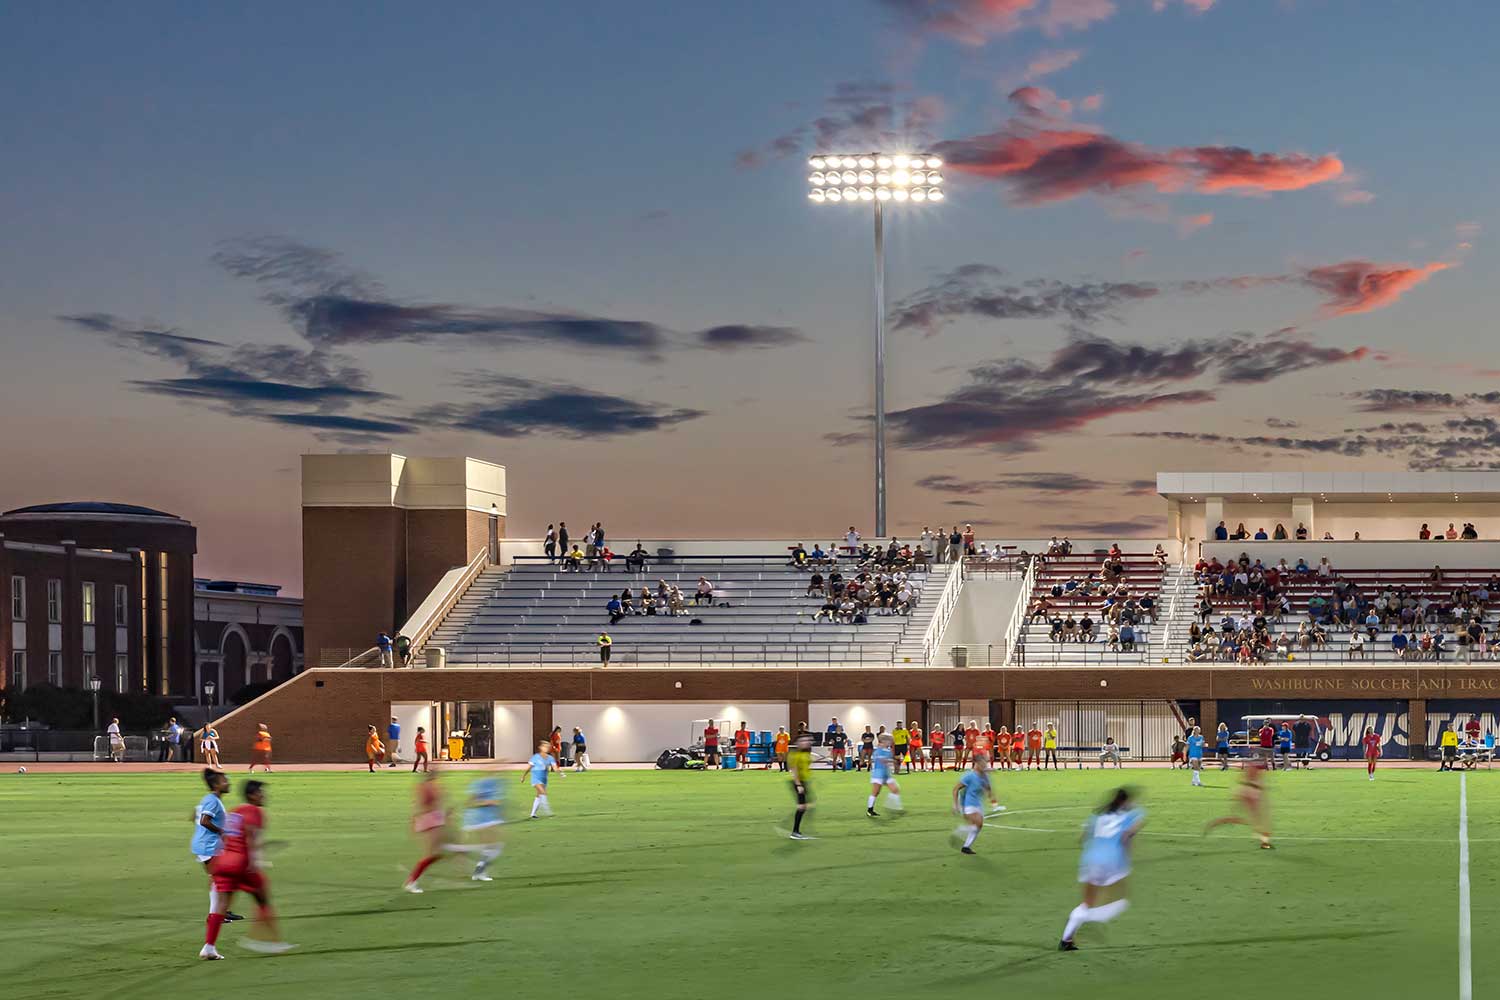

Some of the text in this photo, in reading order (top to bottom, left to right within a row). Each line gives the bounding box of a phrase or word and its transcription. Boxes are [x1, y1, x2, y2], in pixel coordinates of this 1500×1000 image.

[1251, 678, 1345, 690] WASHBURNE
[1351, 678, 1411, 690] SOCCER
[1419, 678, 1451, 689] AND
